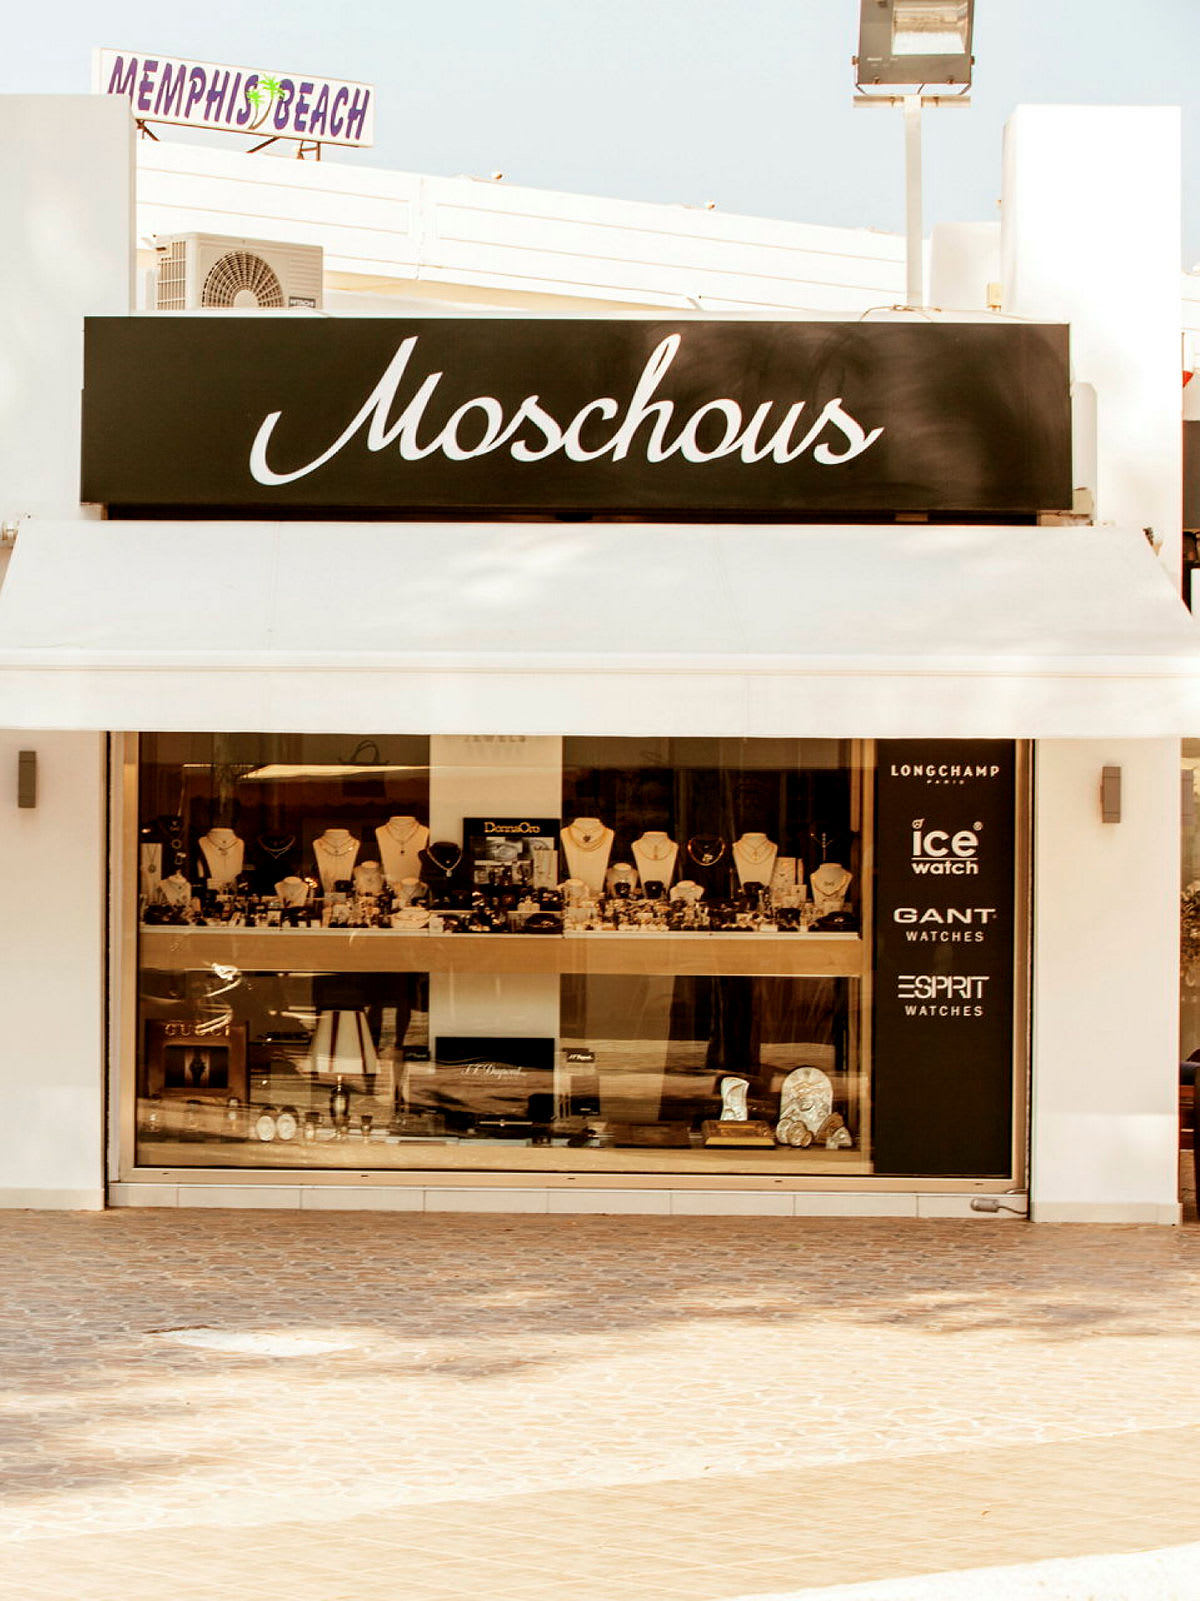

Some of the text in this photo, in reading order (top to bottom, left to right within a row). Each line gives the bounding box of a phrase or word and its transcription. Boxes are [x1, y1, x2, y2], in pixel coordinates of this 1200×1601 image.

[107, 55, 369, 140] MEMPHIS BEACH
[249, 333, 884, 485] Moschous
[891, 764, 999, 777] LONGCHAMP
[912, 818, 980, 858] ice
[911, 860, 979, 875] watch
[893, 907, 997, 924] GANT
[906, 931, 985, 942] WATCHES
[898, 975, 990, 999] ESPRIT
[905, 1005, 984, 1016] WATCHES
